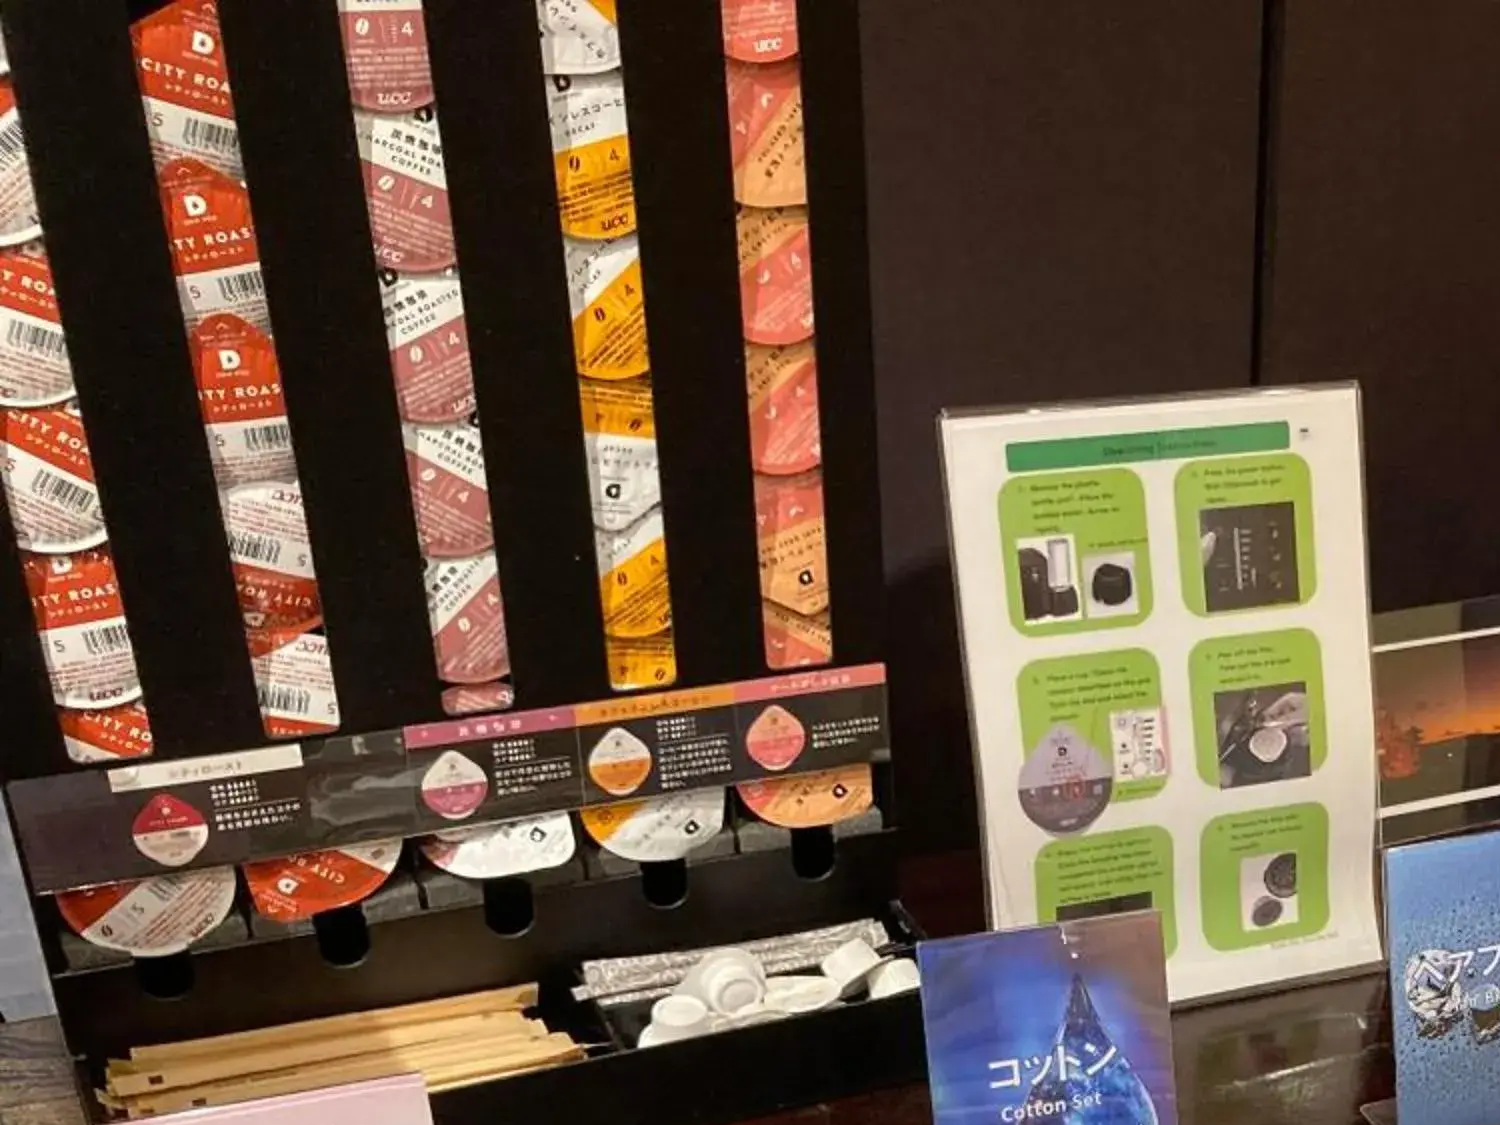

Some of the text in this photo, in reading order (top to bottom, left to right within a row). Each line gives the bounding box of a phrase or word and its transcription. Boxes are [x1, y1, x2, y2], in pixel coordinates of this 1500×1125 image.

[140, 56, 186, 84] CITY
[377, 92, 412, 105] UCC
[988, 1043, 1117, 1090] コットン
[1001, 1091, 1102, 1123] Cotton Set
